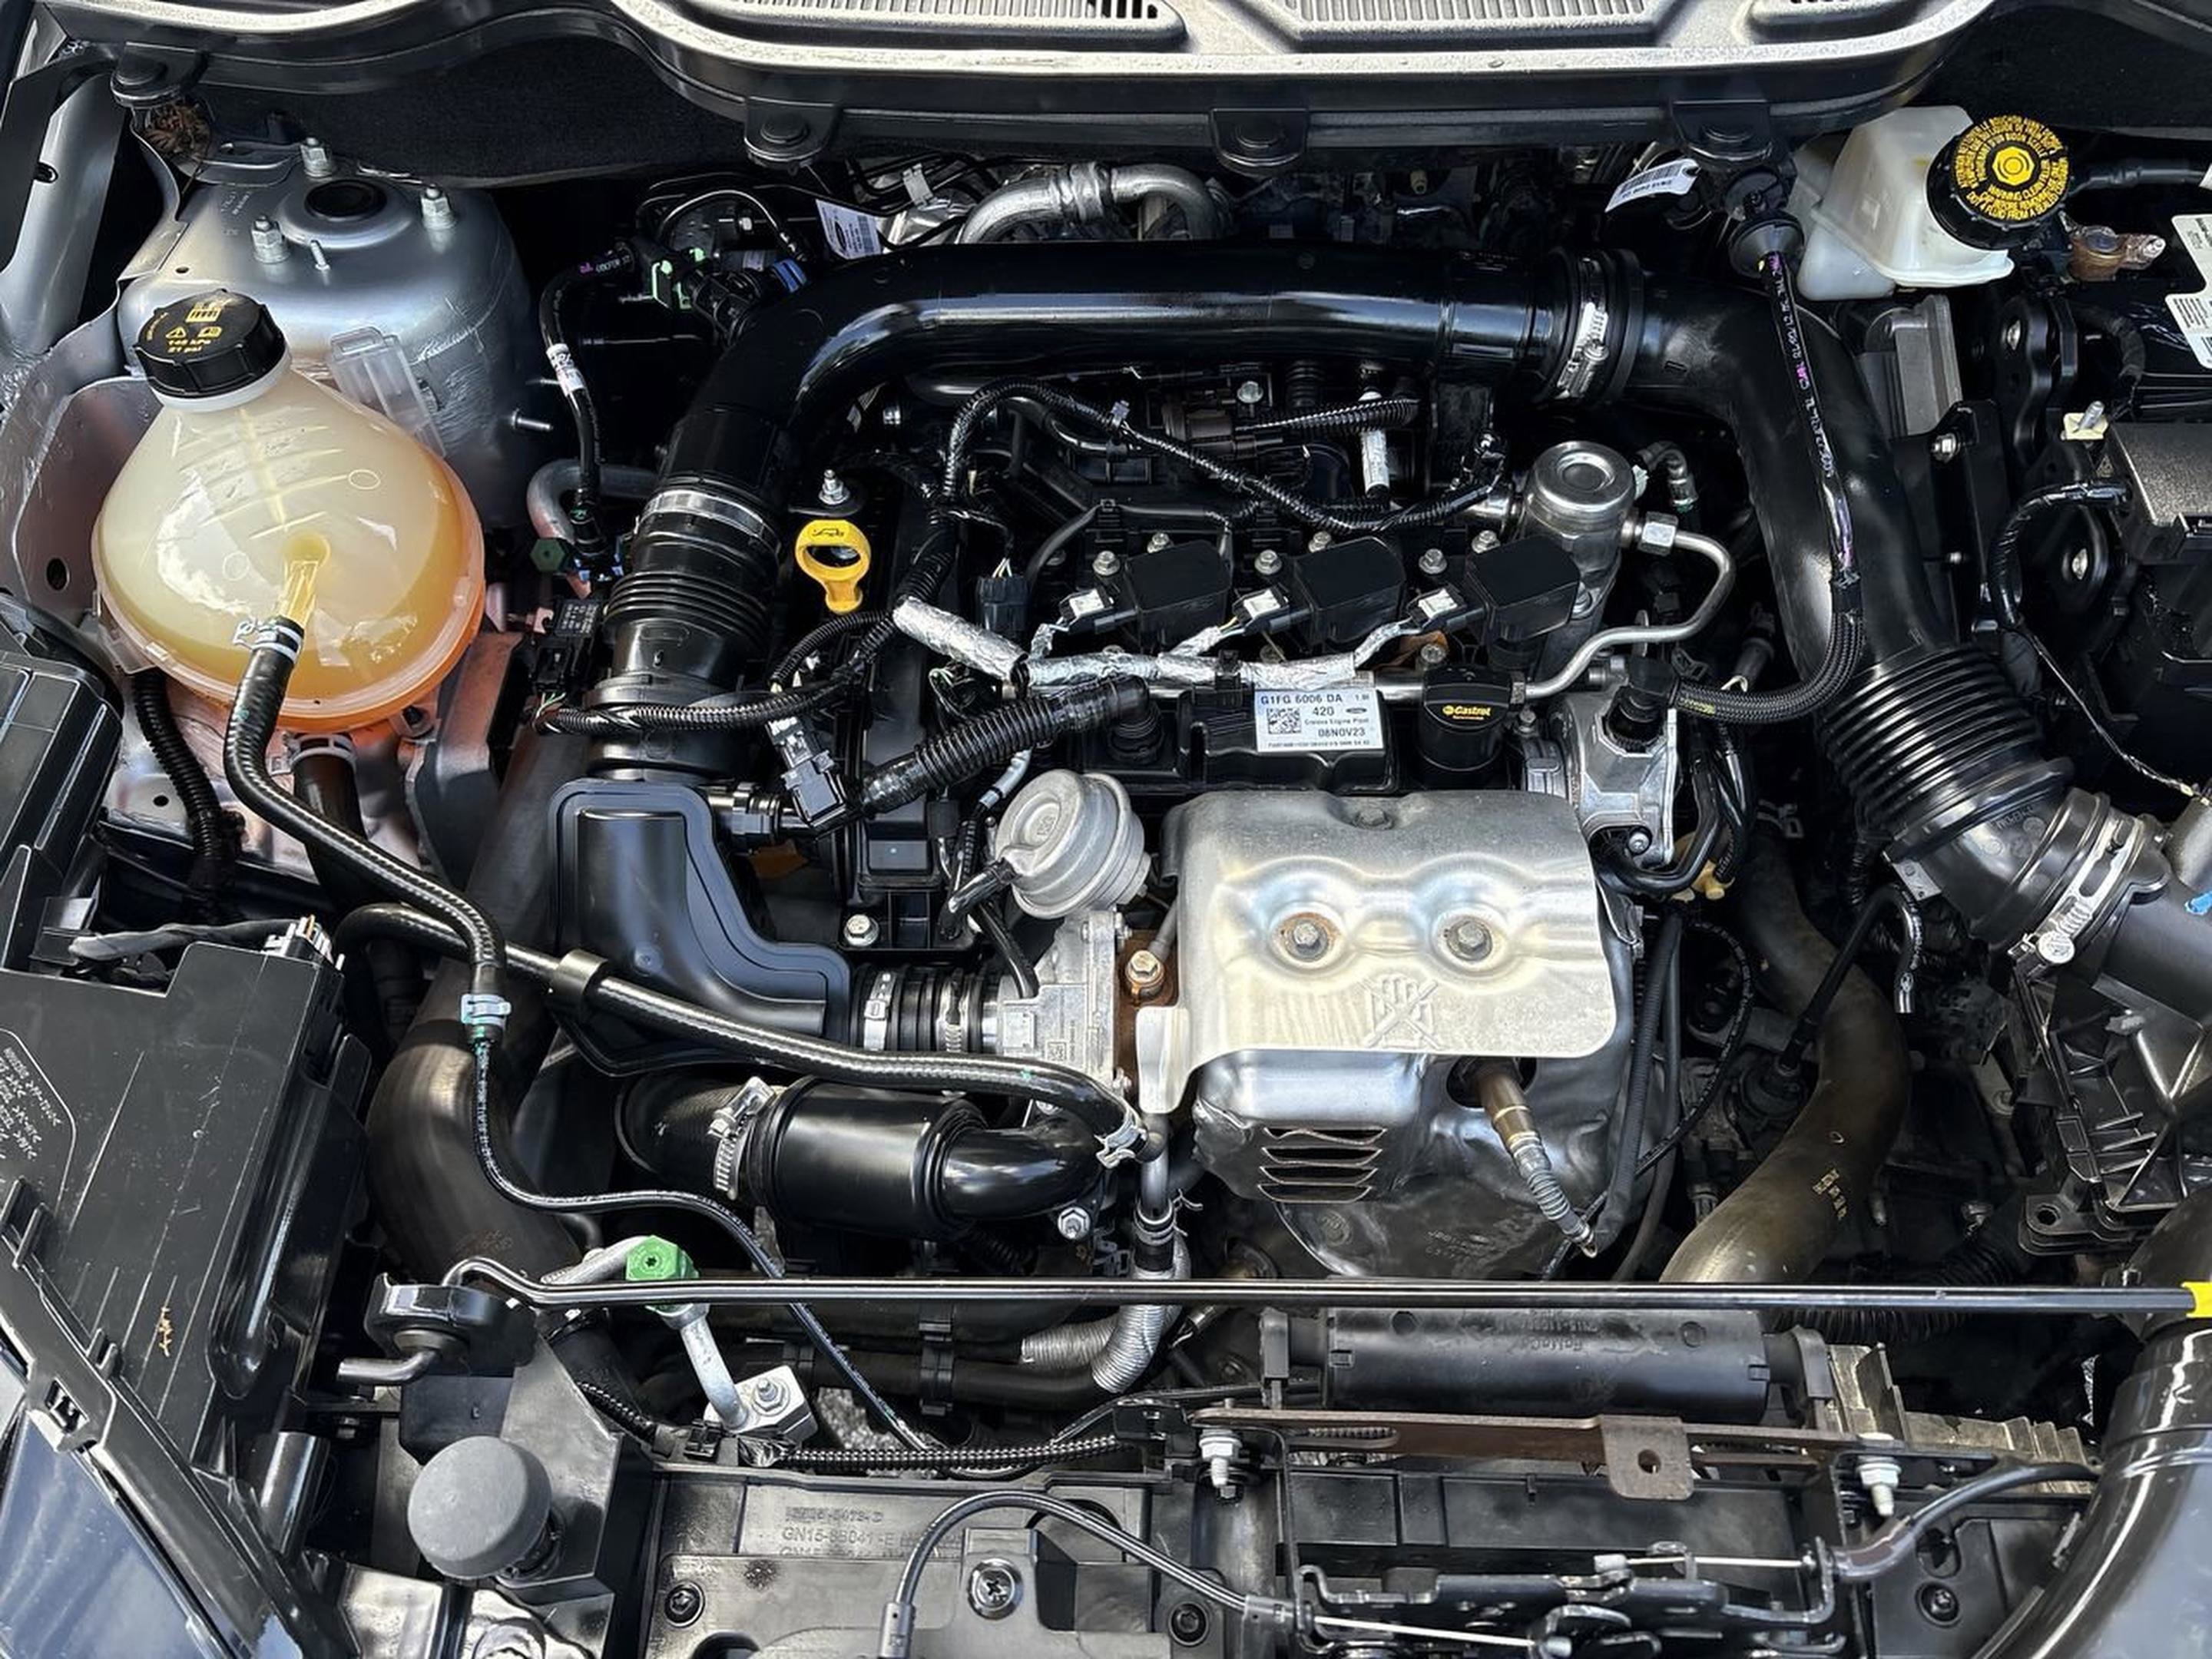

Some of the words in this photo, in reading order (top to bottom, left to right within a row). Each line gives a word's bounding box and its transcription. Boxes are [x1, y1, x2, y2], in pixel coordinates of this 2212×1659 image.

[1326, 694, 1343, 703] DA
[1313, 707, 1335, 716] 420
[1455, 705, 1491, 716] Castrol
